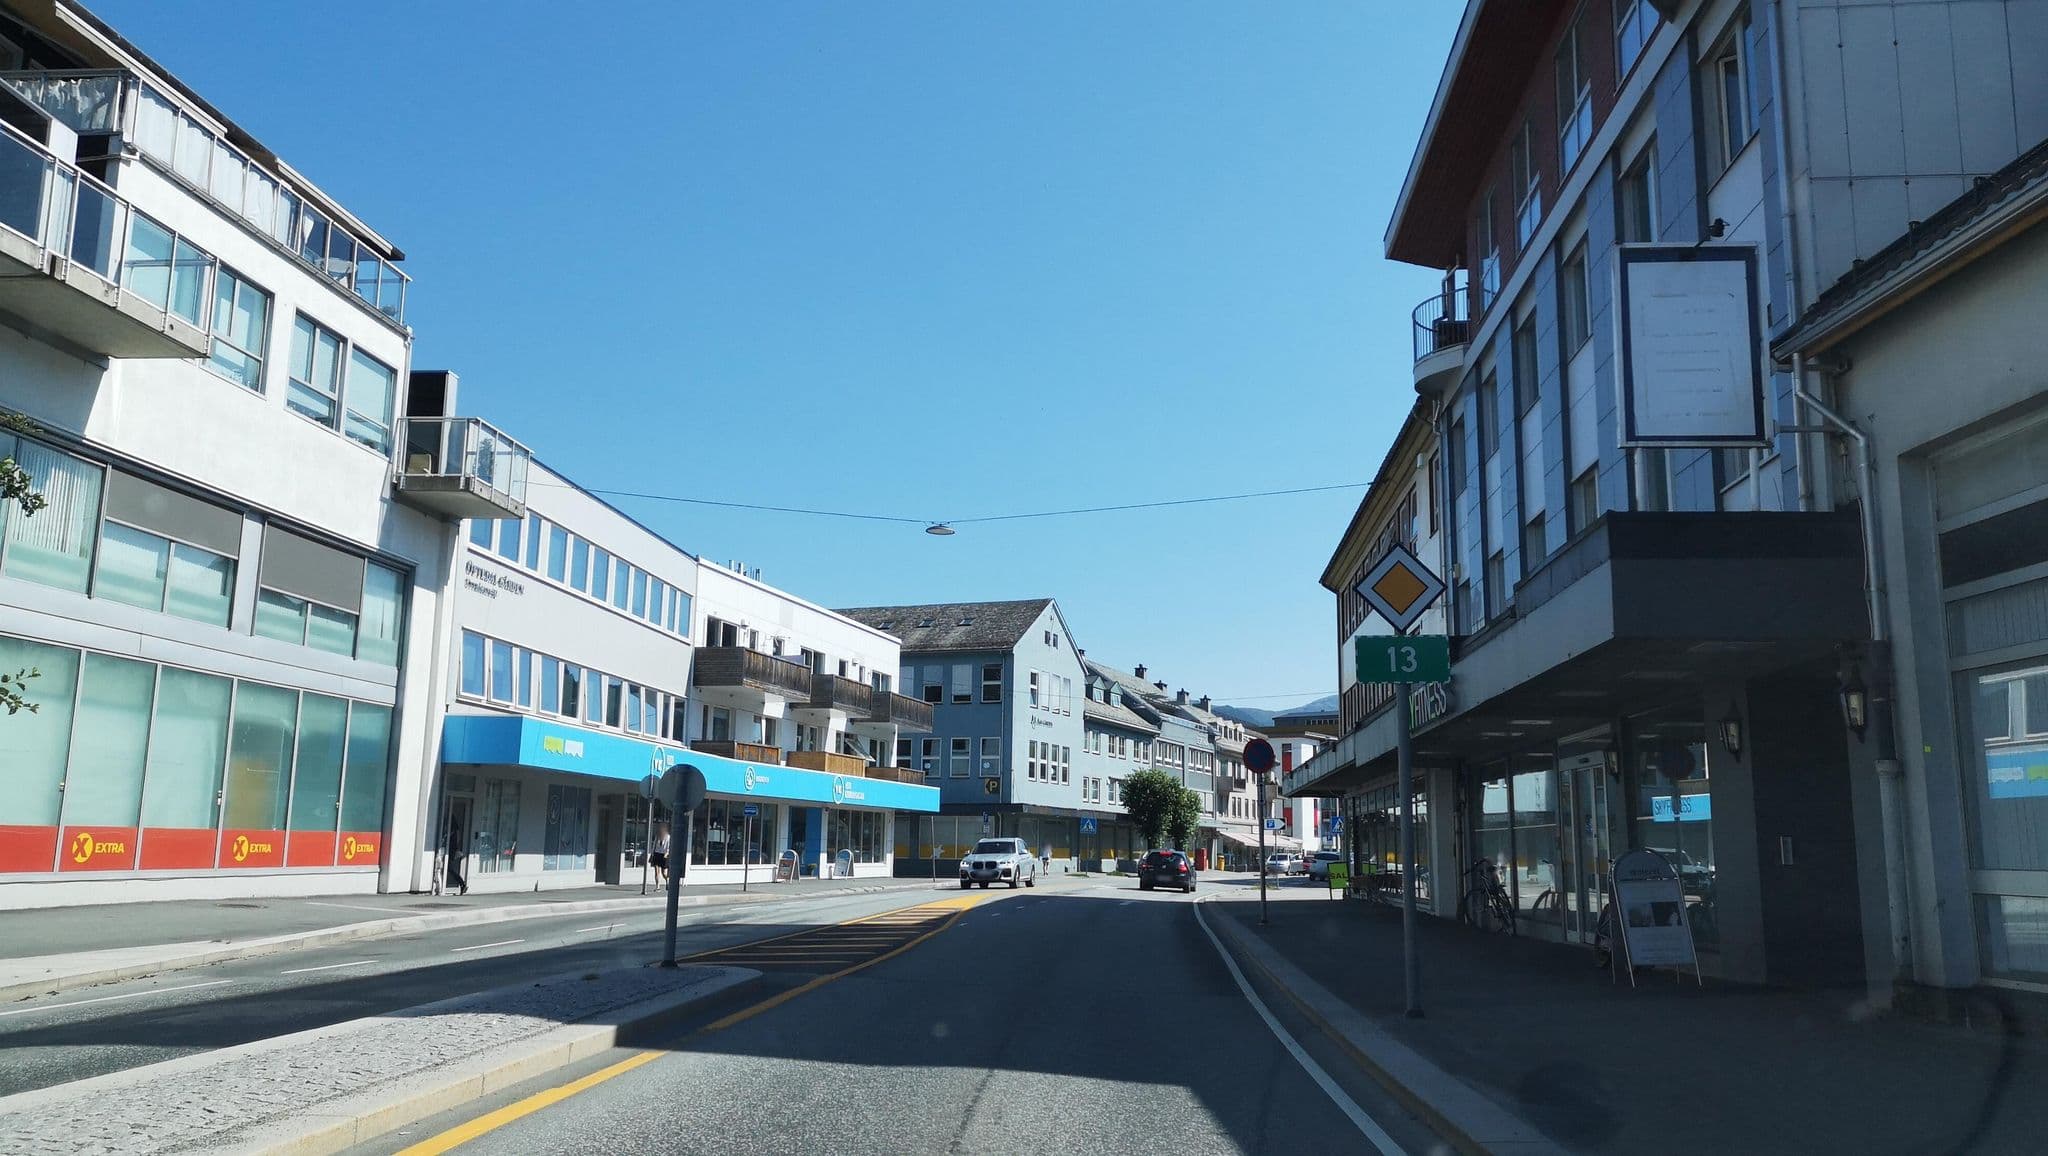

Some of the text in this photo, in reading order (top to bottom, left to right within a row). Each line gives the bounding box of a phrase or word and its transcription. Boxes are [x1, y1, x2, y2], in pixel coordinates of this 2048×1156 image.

[1387, 646, 1418, 673] 13
[989, 781, 998, 791] P
[95, 842, 125, 854] EXTRA
[250, 843, 272, 853] EXTRA
[356, 843, 375, 853] EXTRA
